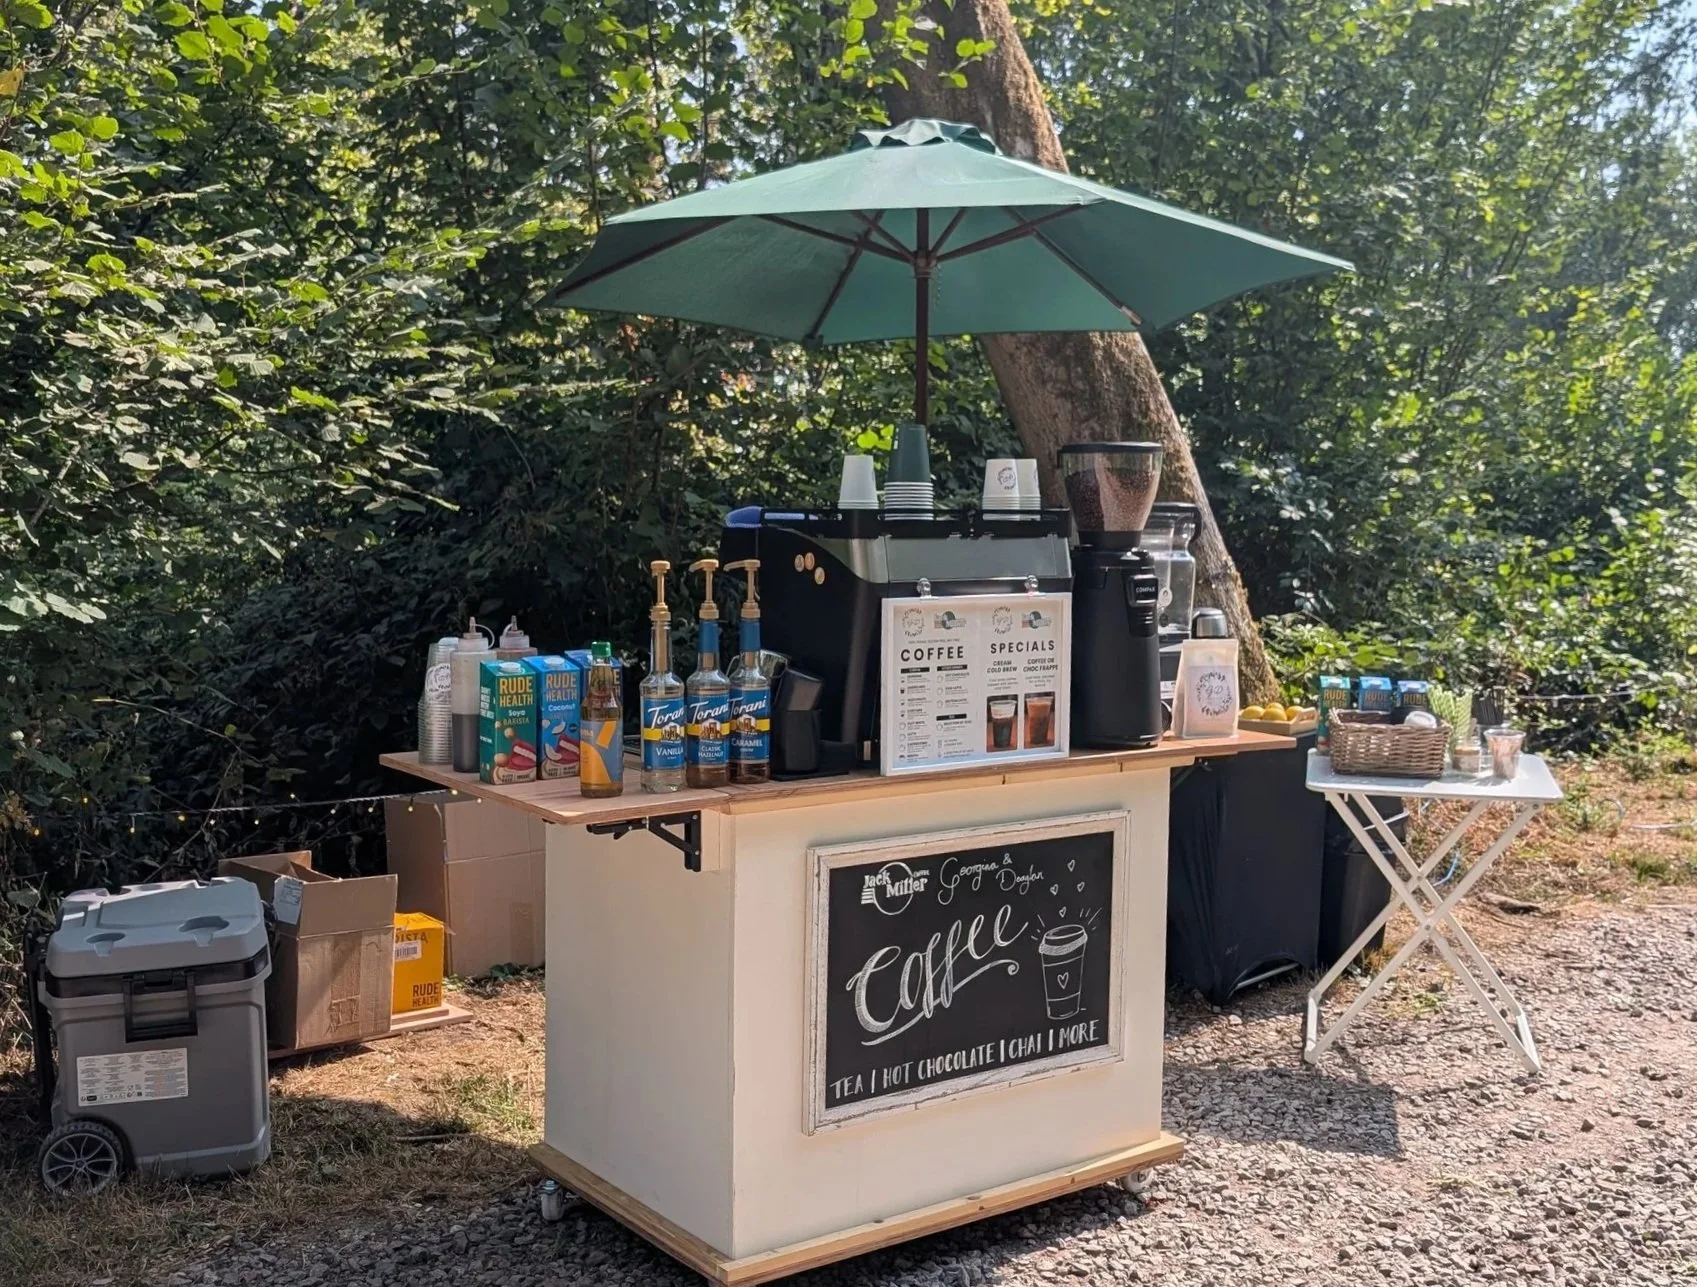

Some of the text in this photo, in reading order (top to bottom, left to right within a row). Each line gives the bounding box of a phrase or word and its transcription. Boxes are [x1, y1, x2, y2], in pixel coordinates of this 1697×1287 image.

[900, 646, 964, 662] COFFEE
[990, 640, 1055, 654] SPECIALS
[1023, 665, 1039, 673] CHOC
[499, 676, 533, 695] RUDE
[545, 672, 577, 689] RUDE
[499, 694, 534, 708] HEALTH
[545, 688, 578, 702] HEALTH
[1324, 689, 1346, 700] RUDE
[508, 709, 526, 717] Soya
[548, 704, 576, 712] Coconut
[729, 695, 767, 720] Torani
[647, 703, 684, 730] Toran
[731, 738, 763, 747] CARAMEL
[862, 869, 892, 889] Jack
[937, 852, 1013, 905] Georgina &
[885, 877, 929, 898] Miller
[846, 903, 1029, 1034] Coffee
[413, 982, 439, 997] RUDE
[412, 997, 439, 1008] HEALTH
[829, 1073, 864, 1100] TEA
[883, 1061, 914, 1089] HOT
[917, 1042, 996, 1081] CHOCOLATE
[1008, 1032, 1042, 1059] CHAI
[1058, 1019, 1101, 1049] MORE
